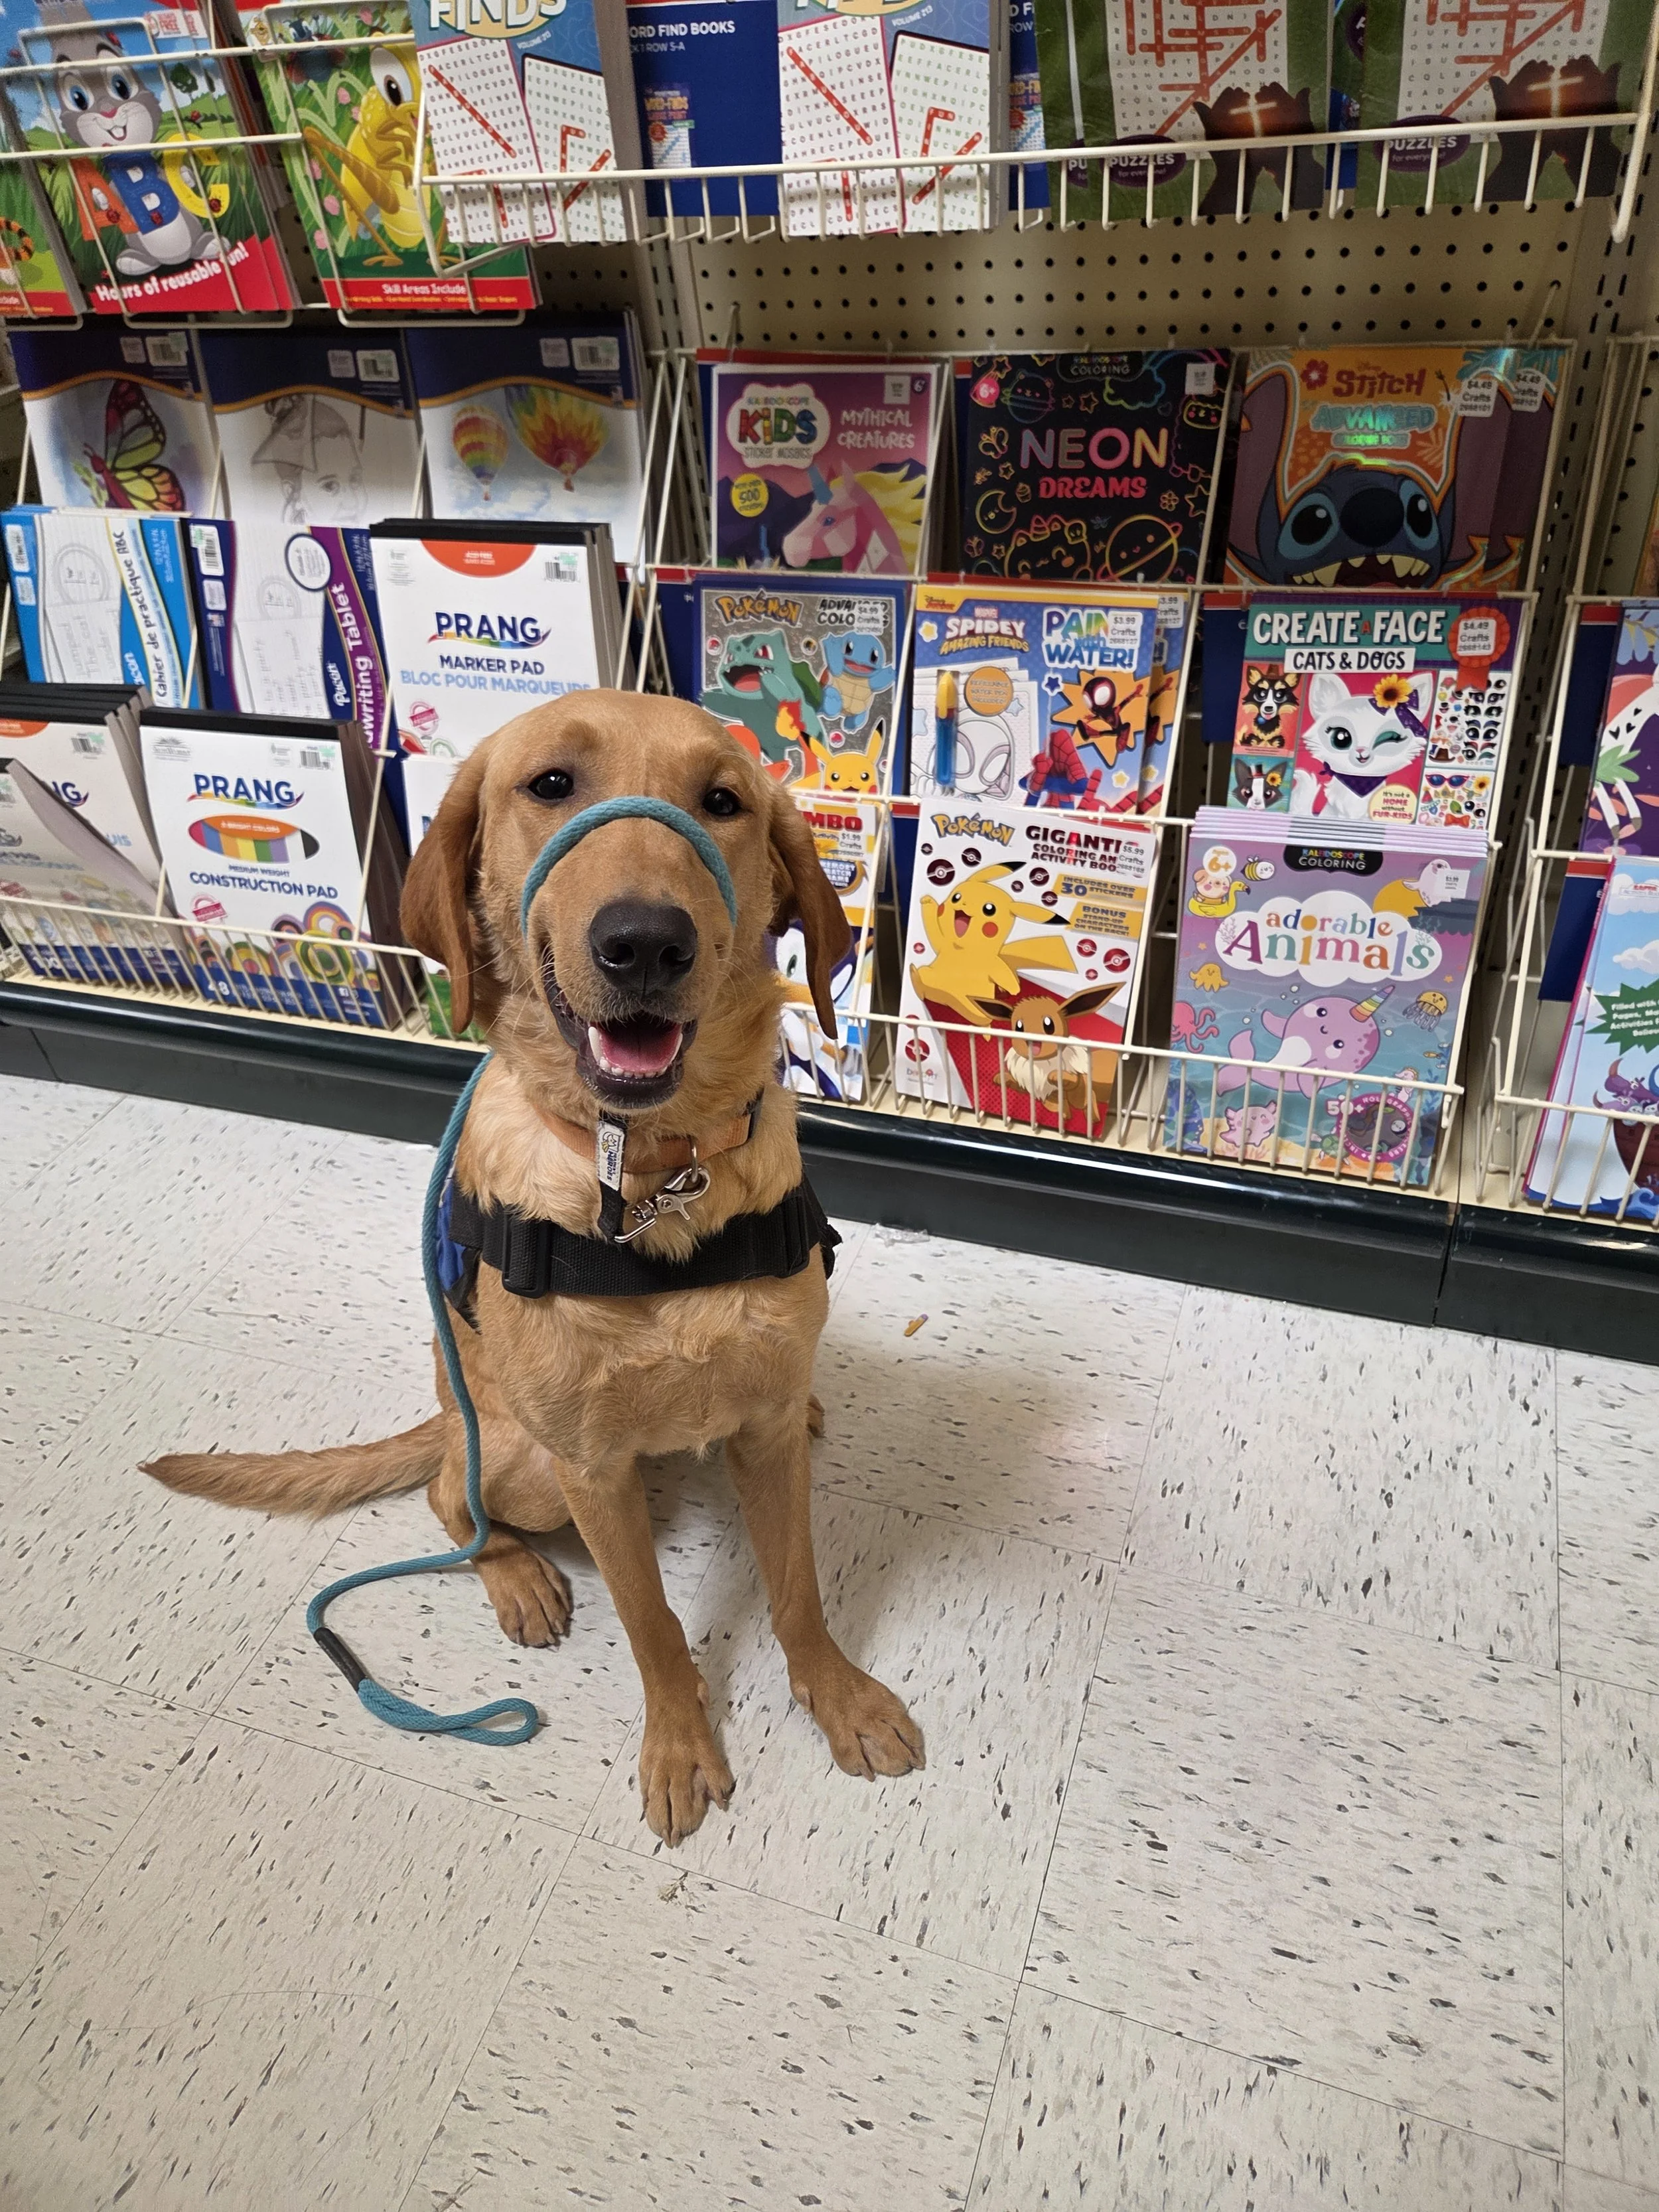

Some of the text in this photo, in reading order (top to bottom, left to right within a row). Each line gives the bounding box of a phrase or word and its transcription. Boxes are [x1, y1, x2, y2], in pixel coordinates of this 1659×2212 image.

[630, 20, 735, 38] ORD FIND BOOKS
[1110, 153, 1175, 167] PUZZES
[96, 240, 250, 303] Hours of reusable un!
[1070, 364, 1130, 376] COLORING
[840, 407, 913, 428] MYTHICAL
[837, 431, 916, 450] CREATURES
[1020, 427, 1169, 470] NEON
[1039, 477, 1147, 500] DREAMS
[334, 583, 364, 651] Tablet
[1046, 610, 1110, 639] PAIN
[1114, 616, 1135, 625] $3.99
[1253, 609, 1447, 644] CREATE A FACE
[1464, 621, 1489, 630] $4.49
[435, 612, 541, 643] PRANG
[946, 617, 1026, 639] SPIDEY
[1111, 628, 1136, 636] Crafts
[144, 632, 159, 650] de
[940, 634, 1030, 656] AMAZING FRIENDS
[1460, 634, 1490, 642] Crafts
[439, 654, 545, 676] MARKER PAD
[1045, 642, 1135, 669] WATER!
[1293, 650, 1407, 670] CATS & DOGS
[123, 652, 145, 685] acon
[151, 654, 168, 698] Cahier
[401, 669, 442, 686] BLOC
[446, 673, 488, 691] POUR
[357, 655, 376, 750] dwriting
[193, 773, 296, 804] PRANG
[1383, 798, 1408, 806] HOME
[803, 812, 862, 831] MBO
[1373, 810, 1413, 820] FUR-KIDS
[1025, 825, 1123, 854] GIGANTI
[1033, 843, 1118, 863] COLORING AN
[1123, 845, 1145, 856] $5.99
[1302, 849, 1365, 861] KALEIDOSCOPE
[822, 861, 856, 871] EMORY
[1031, 852, 1118, 873] ACTIVITY BOO
[1119, 855, 1144, 866] Crafts
[1208, 857, 1232, 873] 6+
[1299, 856, 1367, 871] COLORING
[228, 865, 291, 877] MEDIUM WEIGHT
[189, 871, 338, 900] CONSTRUCTION PAD
[1060, 882, 1134, 899] 30 STICKERS
[1064, 876, 1136, 893] INCLUDES OVER
[1082, 905, 1127, 919] BONUS
[1083, 914, 1124, 924] STAND-UP
[1076, 918, 1129, 930] CHARACTERS
[1266, 909, 1394, 940] adorable
[1222, 919, 1435, 977] Animals
[1611, 999, 1657, 1010] Filled with
[1610, 1020, 1653, 1030] Activities
